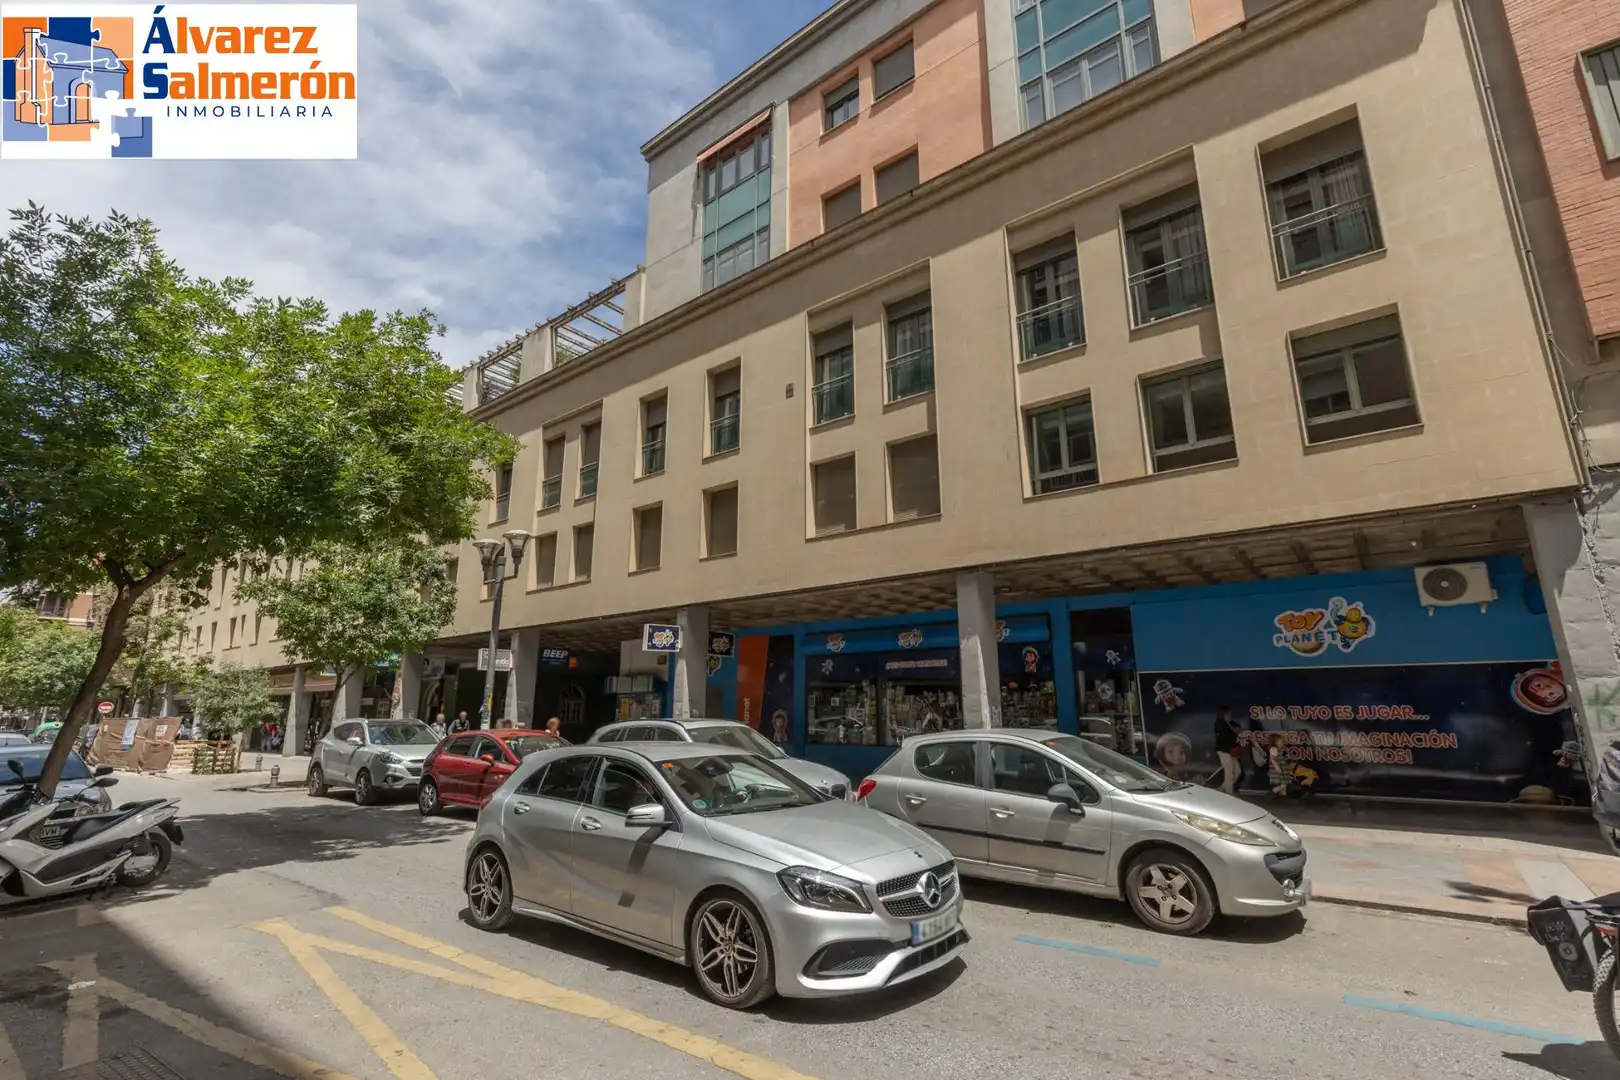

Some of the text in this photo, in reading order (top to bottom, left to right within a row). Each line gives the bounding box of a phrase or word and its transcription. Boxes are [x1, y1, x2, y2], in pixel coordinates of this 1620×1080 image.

[1277, 610, 1326, 632] TOY
[1275, 629, 1339, 645] PLANET
[543, 648, 569, 659] BEEP
[1249, 705, 1430, 720] SI LO TUYO ES JUGAR...
[1336, 729, 1458, 748] IMAGINACIÓN
[1315, 747, 1413, 764] NOSOTROS!
